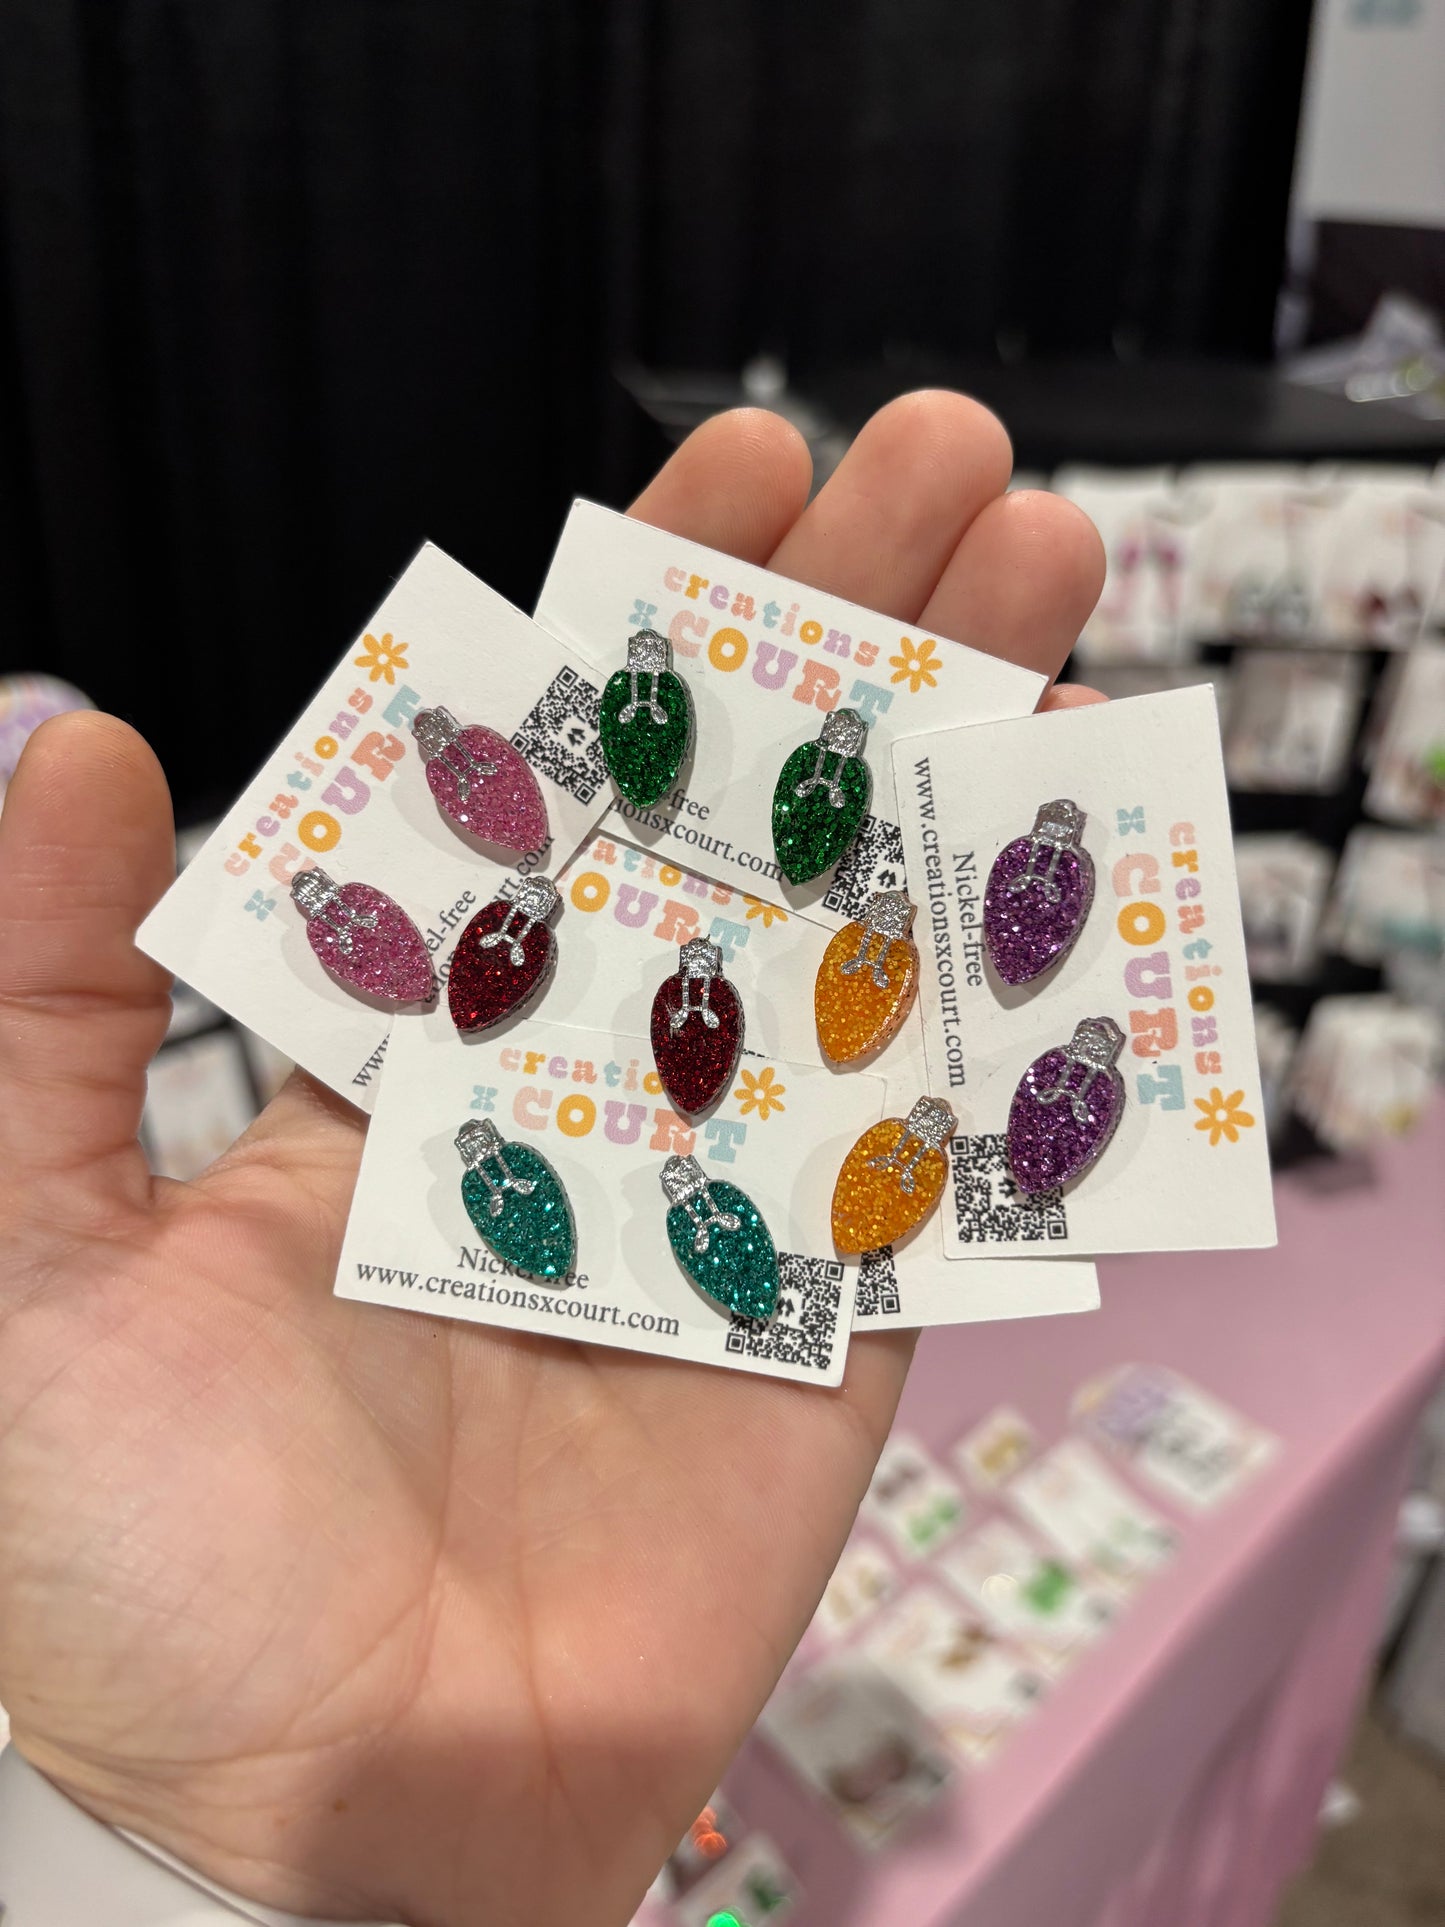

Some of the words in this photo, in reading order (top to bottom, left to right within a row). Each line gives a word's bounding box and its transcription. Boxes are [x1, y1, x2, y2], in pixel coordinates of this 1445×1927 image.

[664, 566, 880, 667] creations
[668, 610, 894, 730] COURT
[224, 688, 373, 876] creations
[269, 685, 424, 887] COURT
[571, 871, 751, 963] OURT
[914, 757, 966, 1088] www.creationsxcourt.com
[953, 851, 984, 987] Nickel-free
[1169, 822, 1223, 1075] creations
[1112, 853, 1186, 1111] COURT
[500, 1047, 664, 1095] creatio
[512, 1086, 747, 1163] COURT
[357, 1262, 680, 1336] www.creationsxcourt.com
